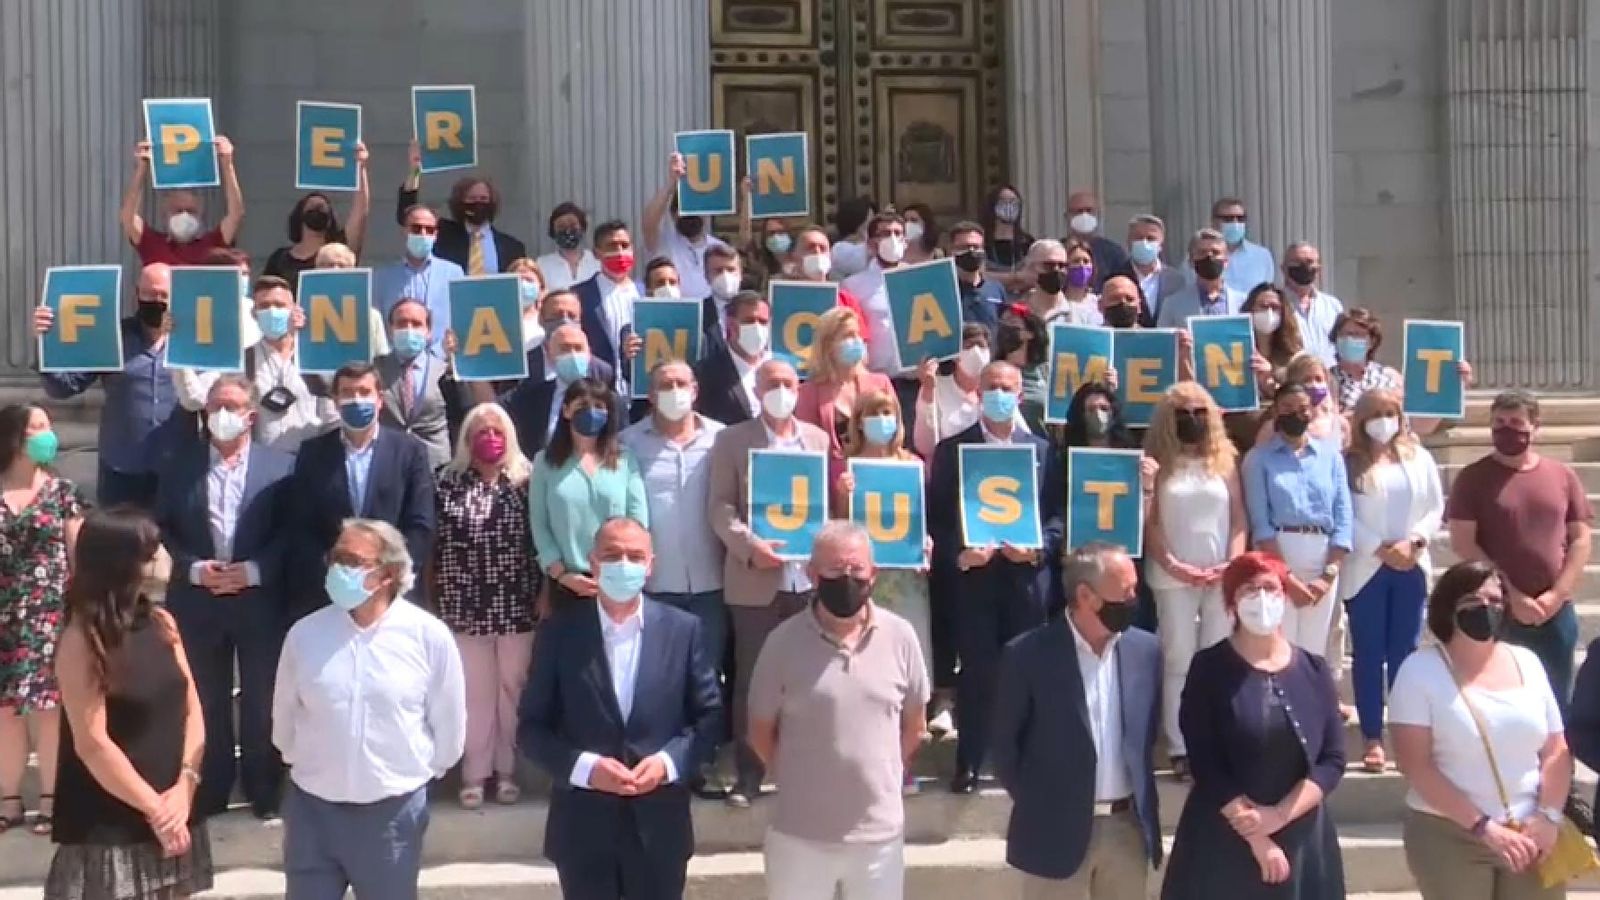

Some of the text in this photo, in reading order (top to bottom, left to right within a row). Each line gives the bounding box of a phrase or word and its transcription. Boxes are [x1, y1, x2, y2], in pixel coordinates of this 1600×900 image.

[161, 124, 200, 165] P
[311, 127, 346, 167] E
[425, 110, 463, 151] R
[684, 153, 722, 192] U
[757, 156, 795, 194] N
[58, 294, 101, 343] F
[194, 297, 213, 345] I
[309, 294, 358, 343] N
[464, 307, 512, 356] A
[907, 293, 954, 344] A
[1126, 357, 1166, 403] E
[1204, 340, 1245, 387] N
[1416, 349, 1454, 394] T
[766, 475, 810, 531] J
[865, 492, 911, 542] U
[977, 476, 1024, 525] S
[1083, 480, 1127, 531] T
